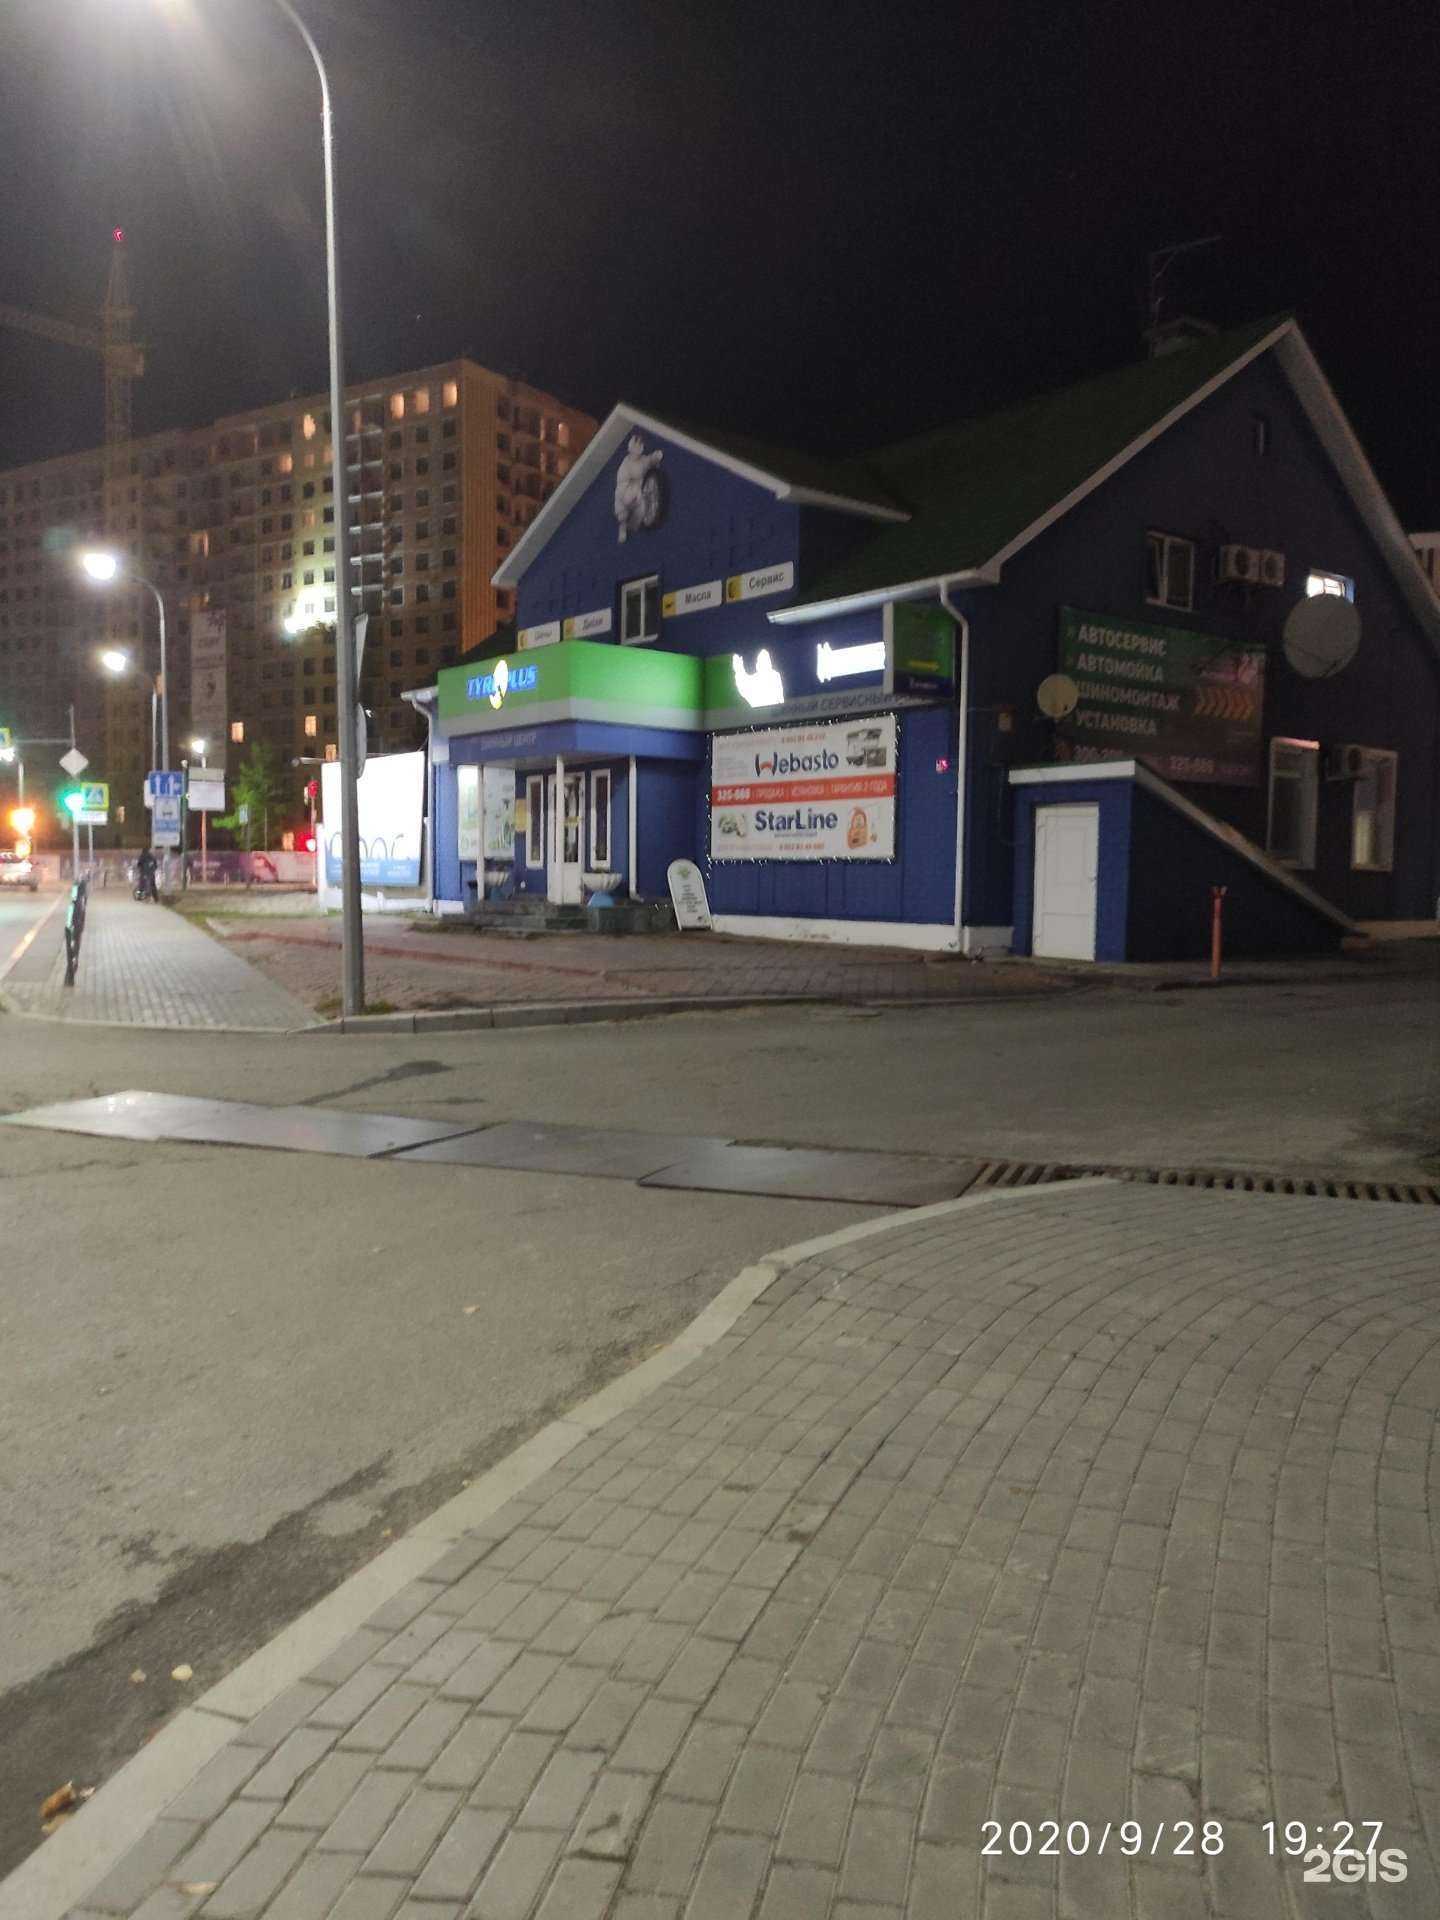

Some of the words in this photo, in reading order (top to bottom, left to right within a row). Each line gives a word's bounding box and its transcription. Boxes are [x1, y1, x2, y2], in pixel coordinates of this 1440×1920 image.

[749, 571, 785, 590] Сервис
[685, 589, 712, 604] Масла
[1078, 624, 1167, 657] АВТОСЕРВИС
[754, 748, 840, 777] Webasto
[754, 807, 839, 833] StarLine
